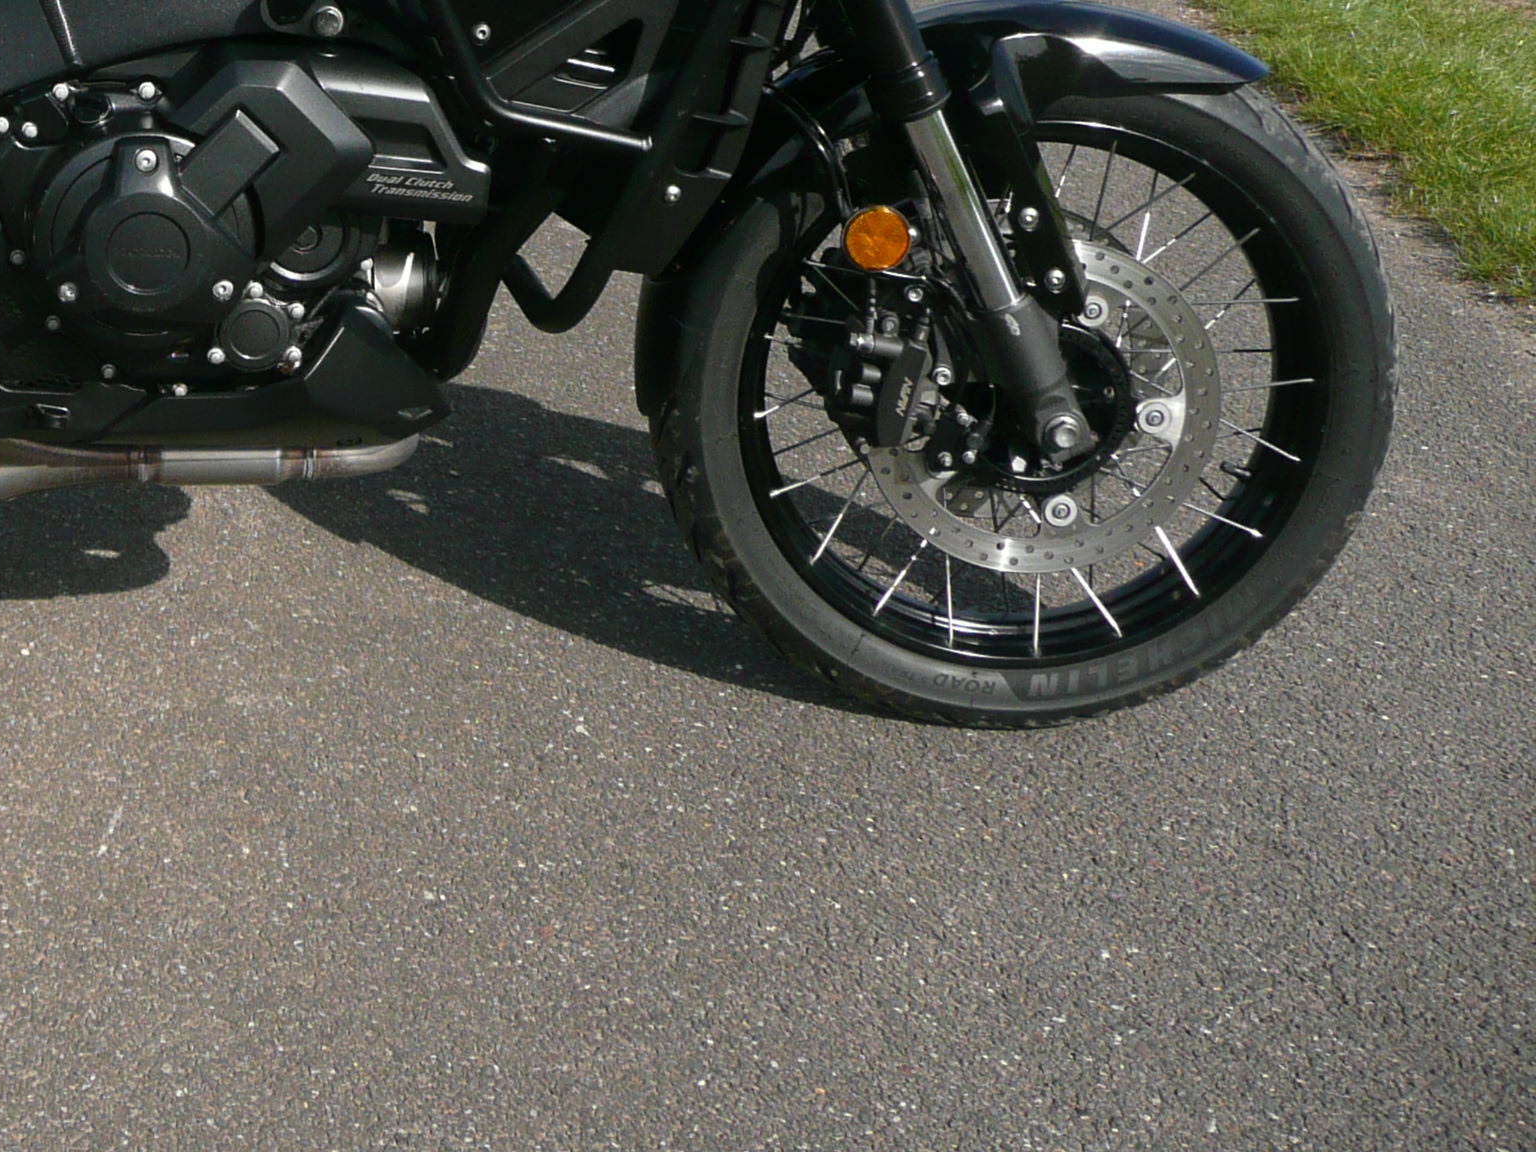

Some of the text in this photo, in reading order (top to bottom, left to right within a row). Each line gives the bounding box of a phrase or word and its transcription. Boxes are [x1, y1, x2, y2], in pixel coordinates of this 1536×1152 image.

[367, 173, 454, 190] Dual Clutch
[372, 184, 473, 202] Transmission
[931, 673, 998, 698] ROAD
